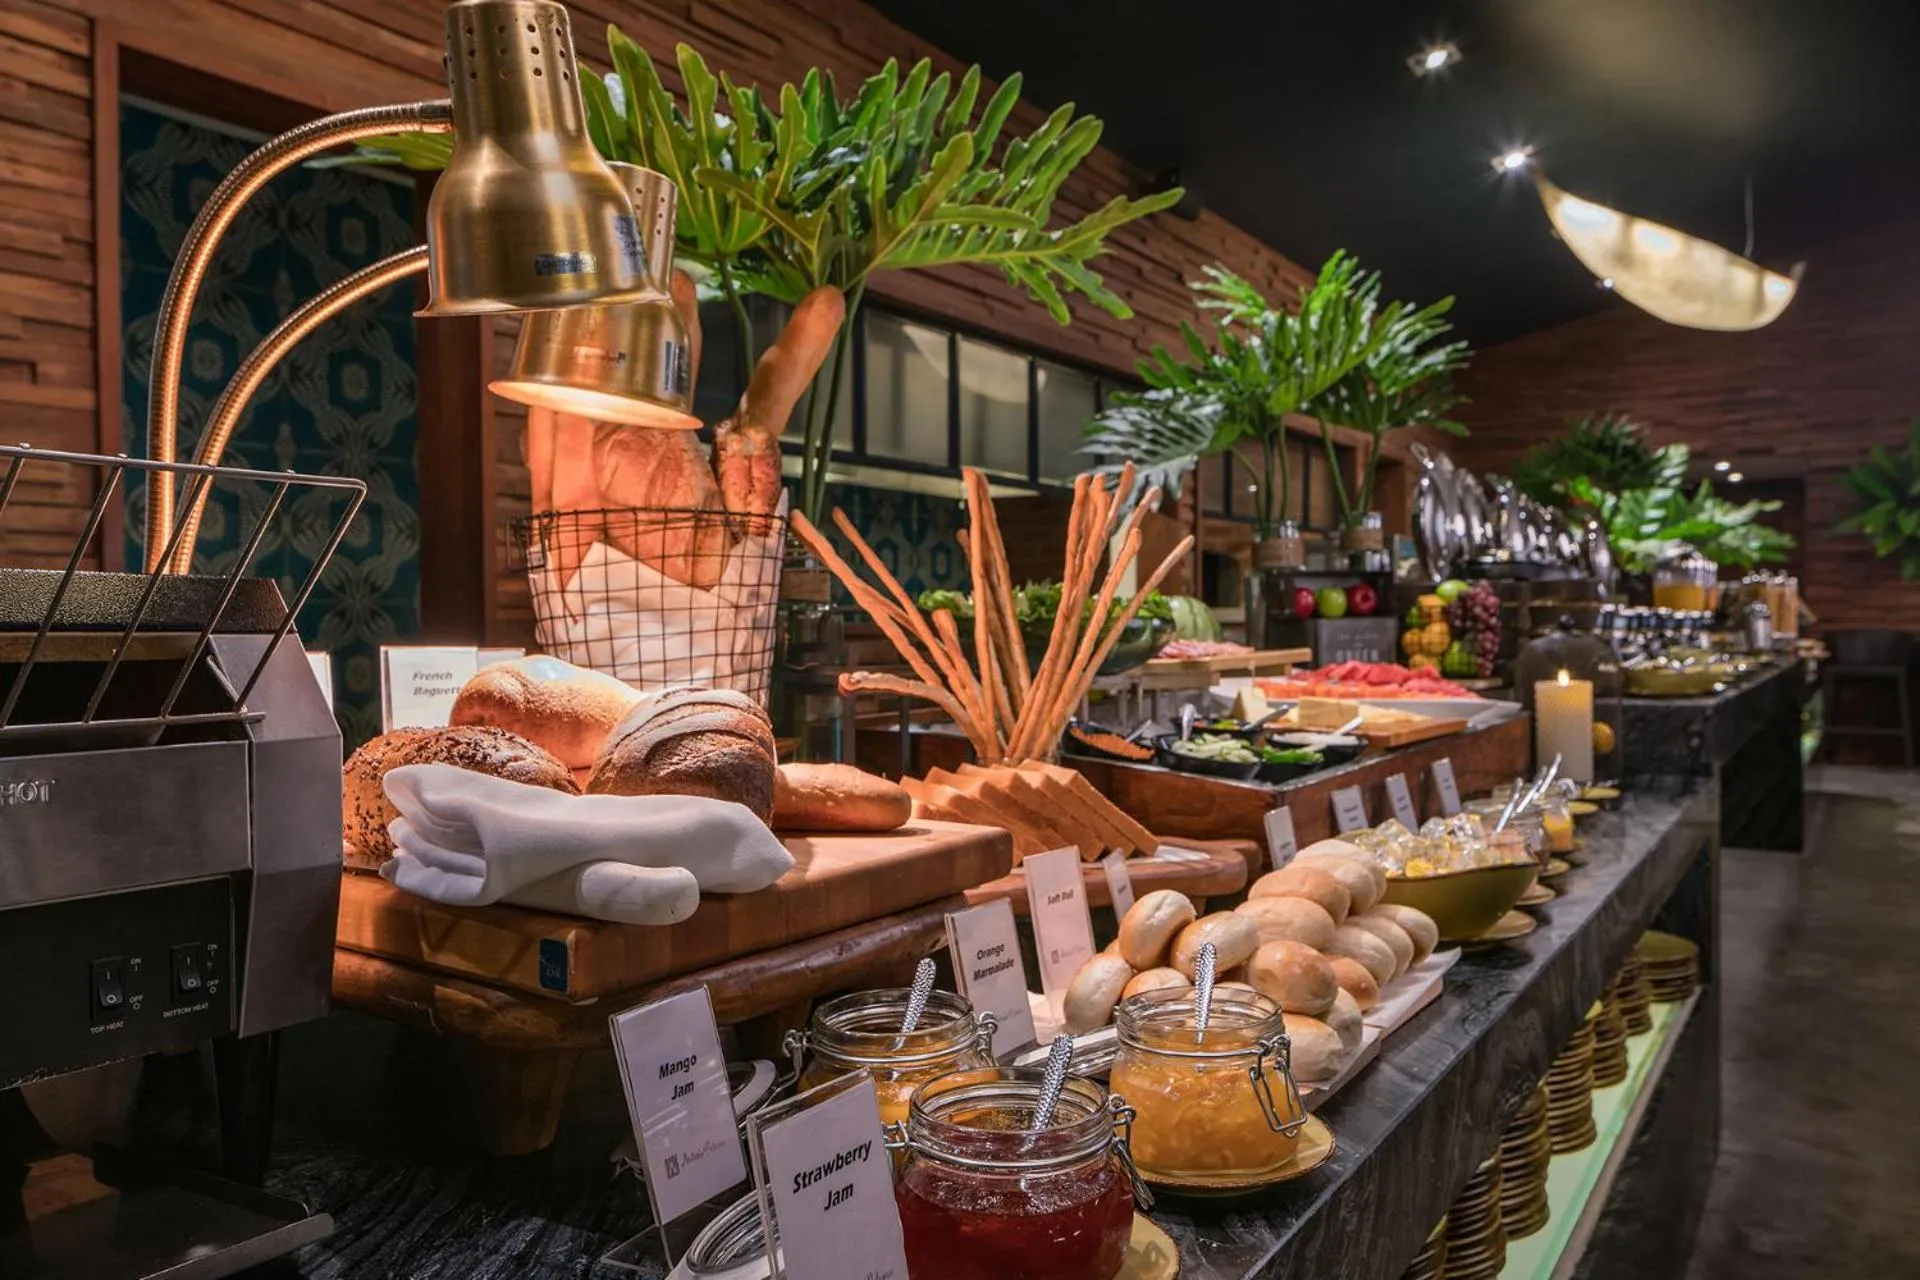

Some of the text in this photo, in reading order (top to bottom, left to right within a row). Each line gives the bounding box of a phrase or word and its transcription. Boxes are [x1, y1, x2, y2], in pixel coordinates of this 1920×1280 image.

[412, 671, 453, 681] French
[413, 686, 461, 697] Baguett
[1047, 889, 1074, 905] Soft Roll
[976, 943, 1006, 960] Orange
[973, 958, 1015, 981] Marmalade
[163, 1002, 209, 1018] BOTTOM HEAT
[90, 1021, 124, 1034] TOP HEAT
[658, 1054, 698, 1081] Mango
[671, 1081, 695, 1101] Jam
[792, 1139, 873, 1195] Strawberry
[823, 1183, 854, 1212] Jam
